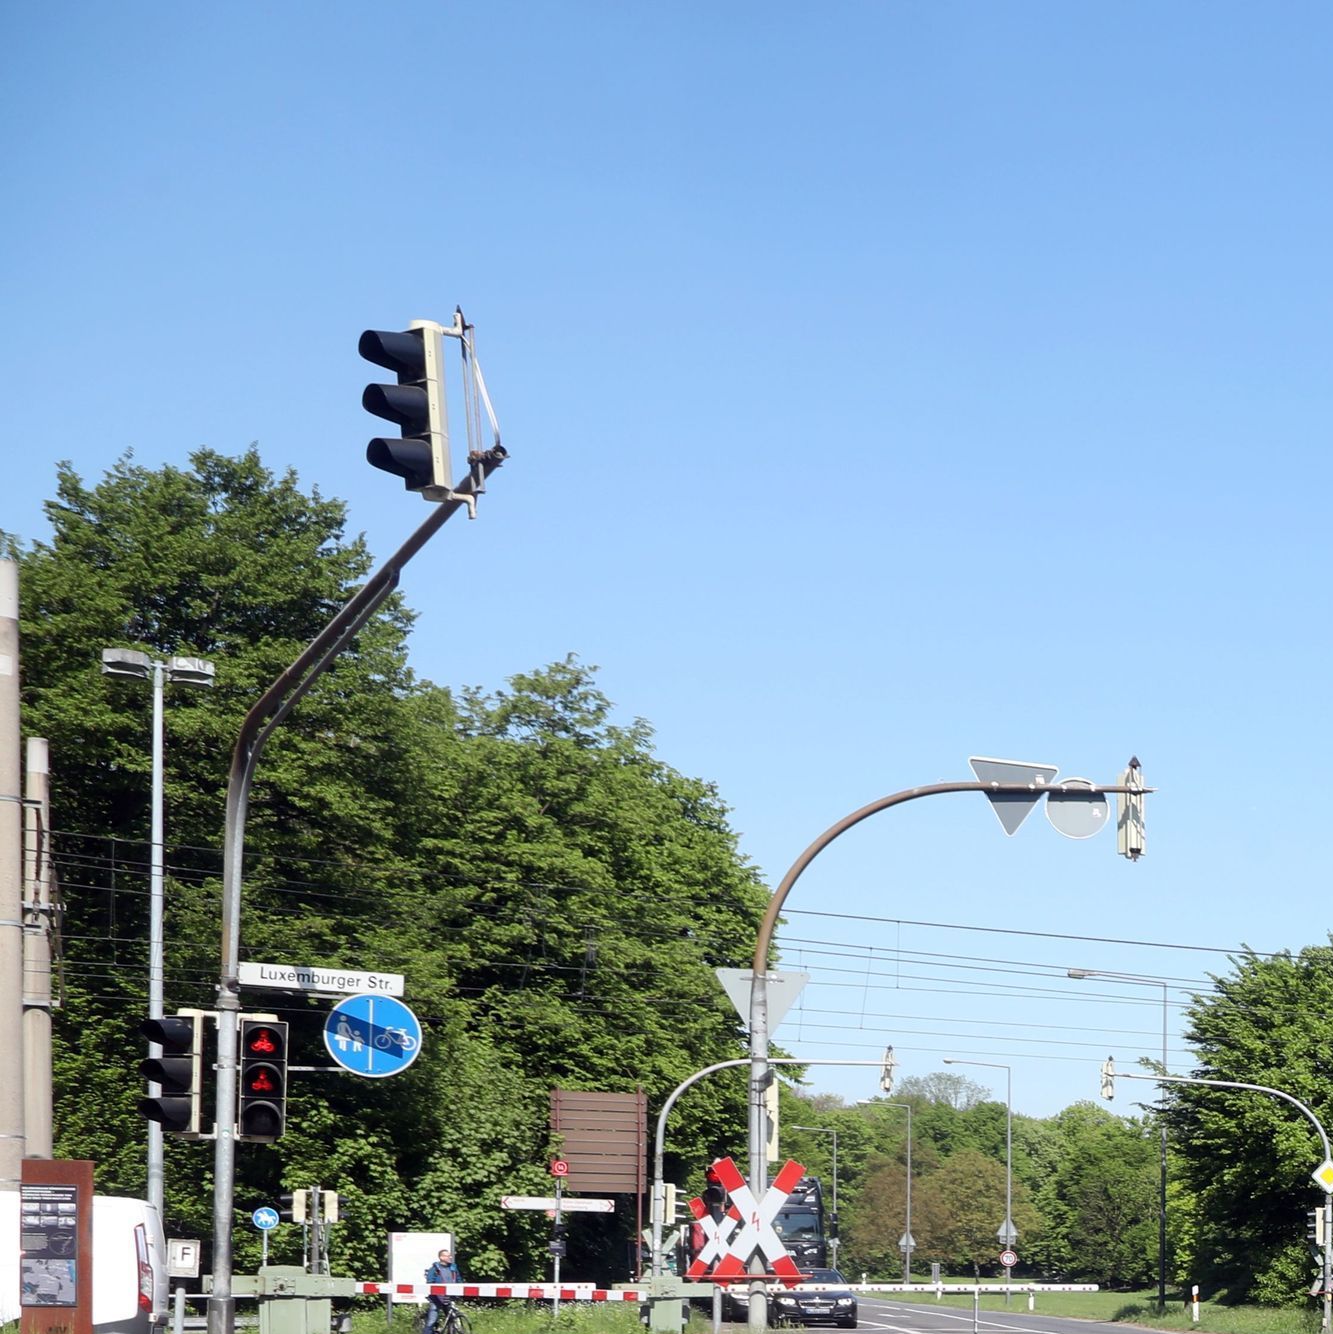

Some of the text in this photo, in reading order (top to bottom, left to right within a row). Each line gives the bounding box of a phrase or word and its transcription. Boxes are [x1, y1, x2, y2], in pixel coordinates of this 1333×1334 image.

[260, 966, 393, 990] Luxemburger Str.
[181, 1246, 191, 1261] F
